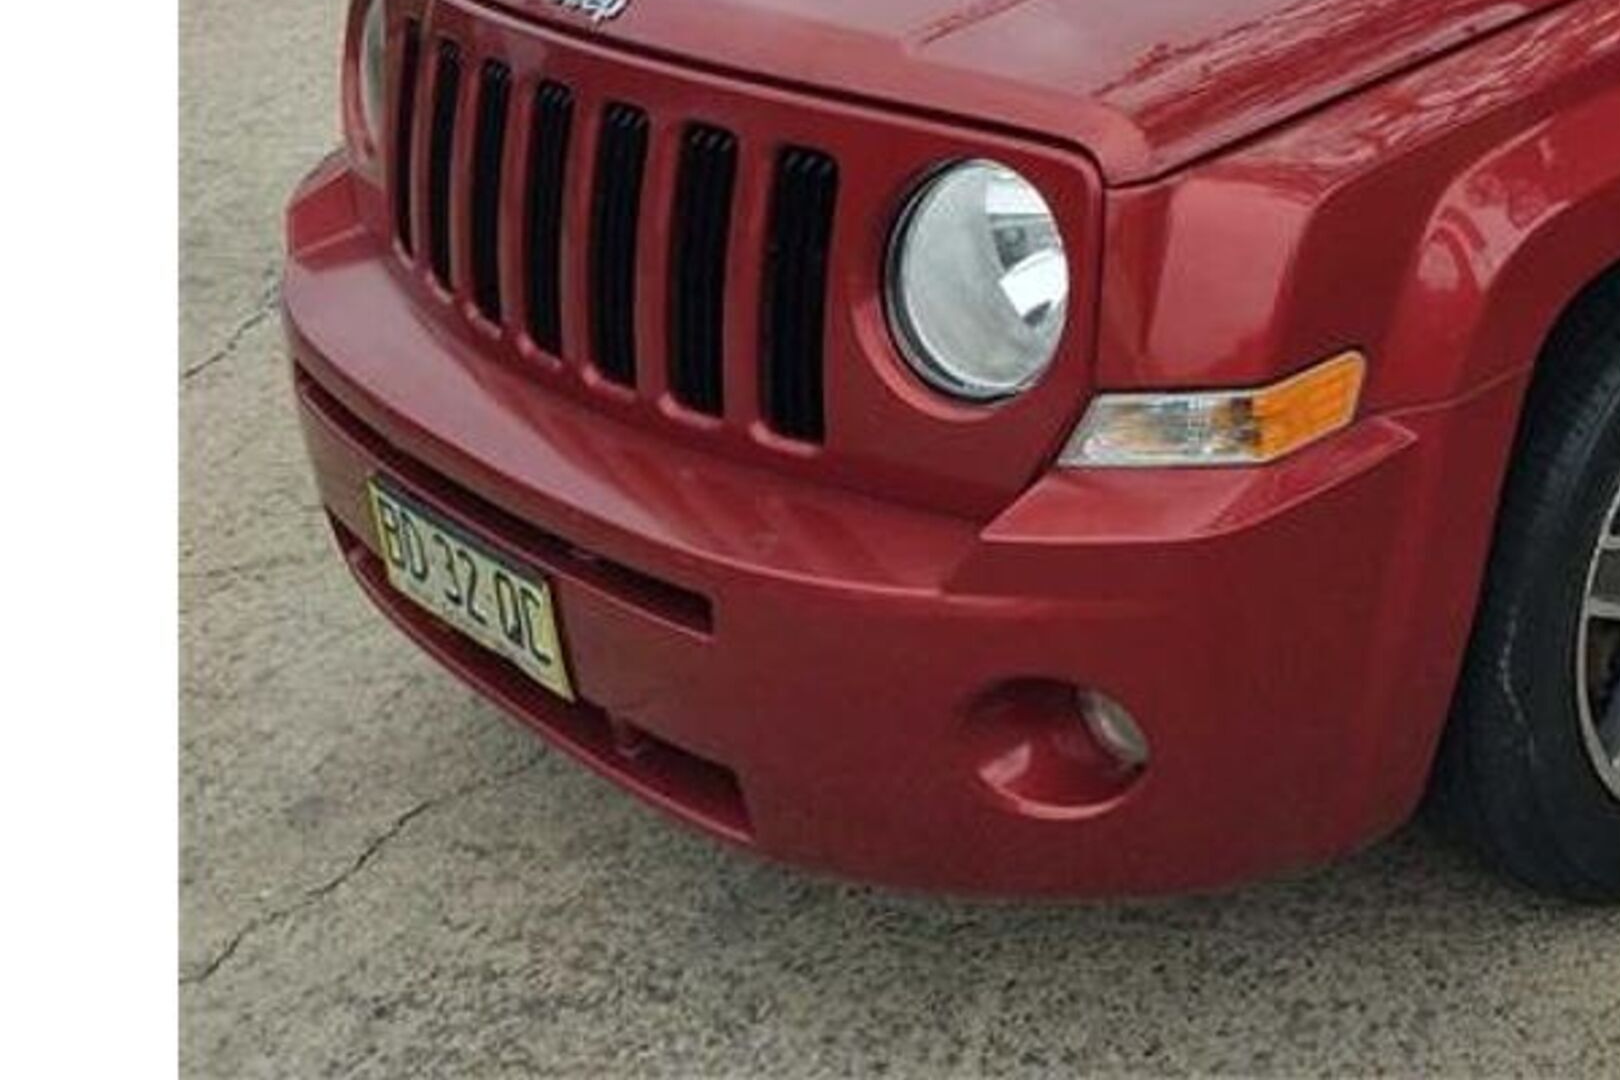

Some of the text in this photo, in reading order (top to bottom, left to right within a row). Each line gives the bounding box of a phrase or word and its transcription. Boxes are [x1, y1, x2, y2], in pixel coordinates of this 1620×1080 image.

[376, 495, 553, 666] BD 32 QC
